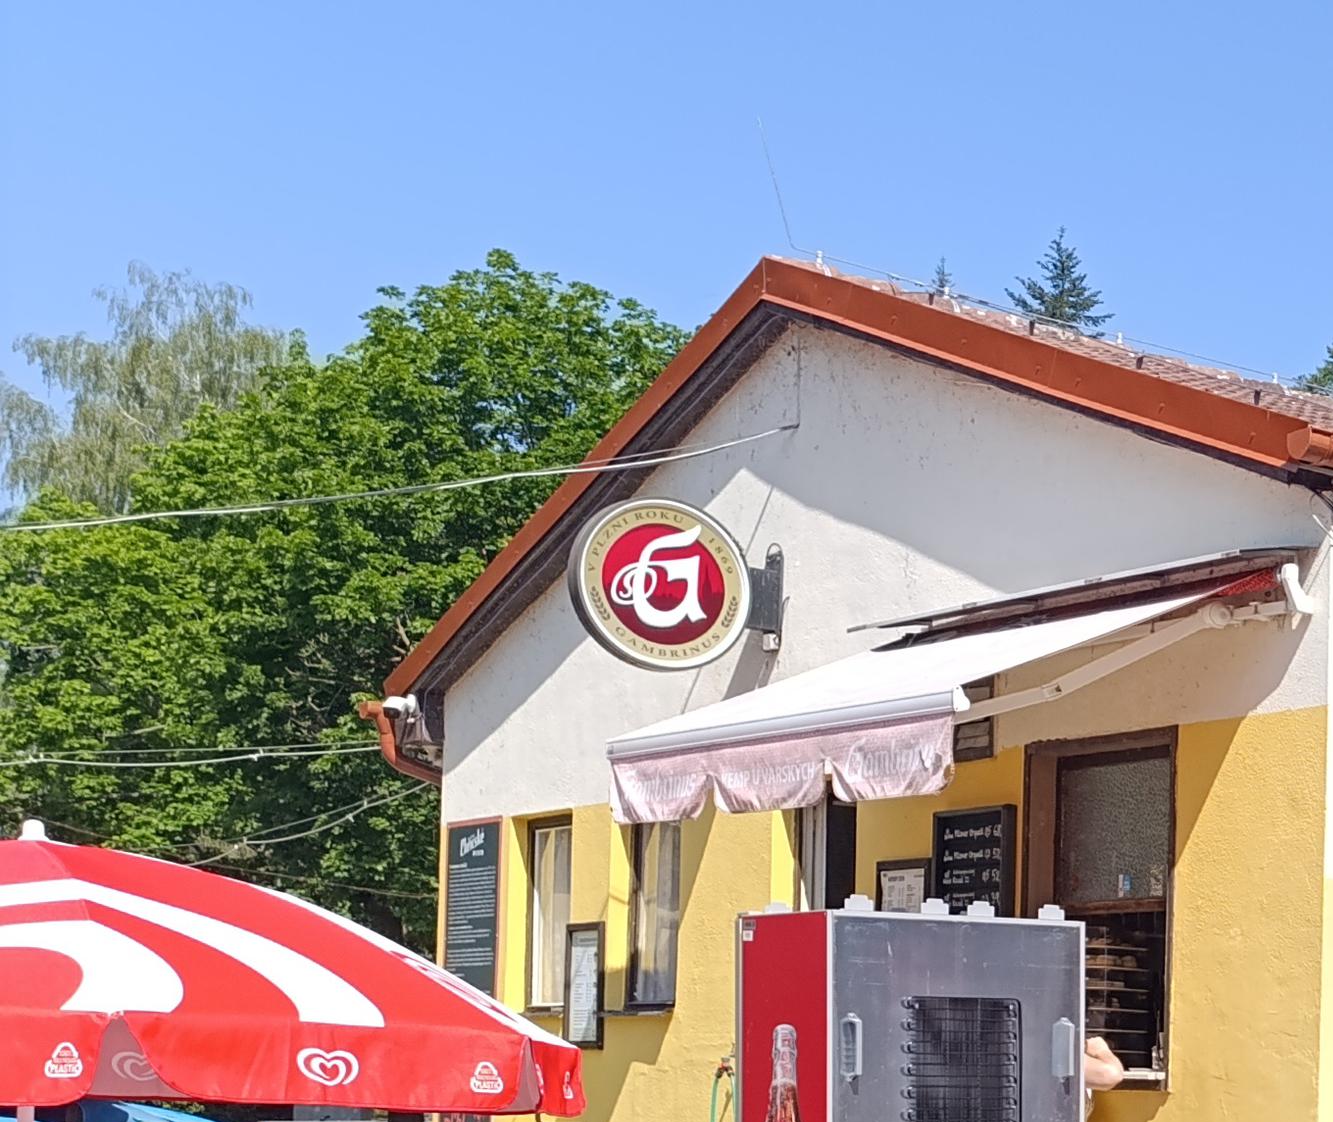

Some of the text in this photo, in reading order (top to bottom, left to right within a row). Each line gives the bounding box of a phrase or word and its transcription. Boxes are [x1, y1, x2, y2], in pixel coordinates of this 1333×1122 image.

[634, 509, 685, 525] ROKU
[708, 537, 734, 575] 1869
[615, 626, 721, 658] GAMBRINUS
[721, 770, 750, 789] KEMP
[752, 767, 761, 785] U
